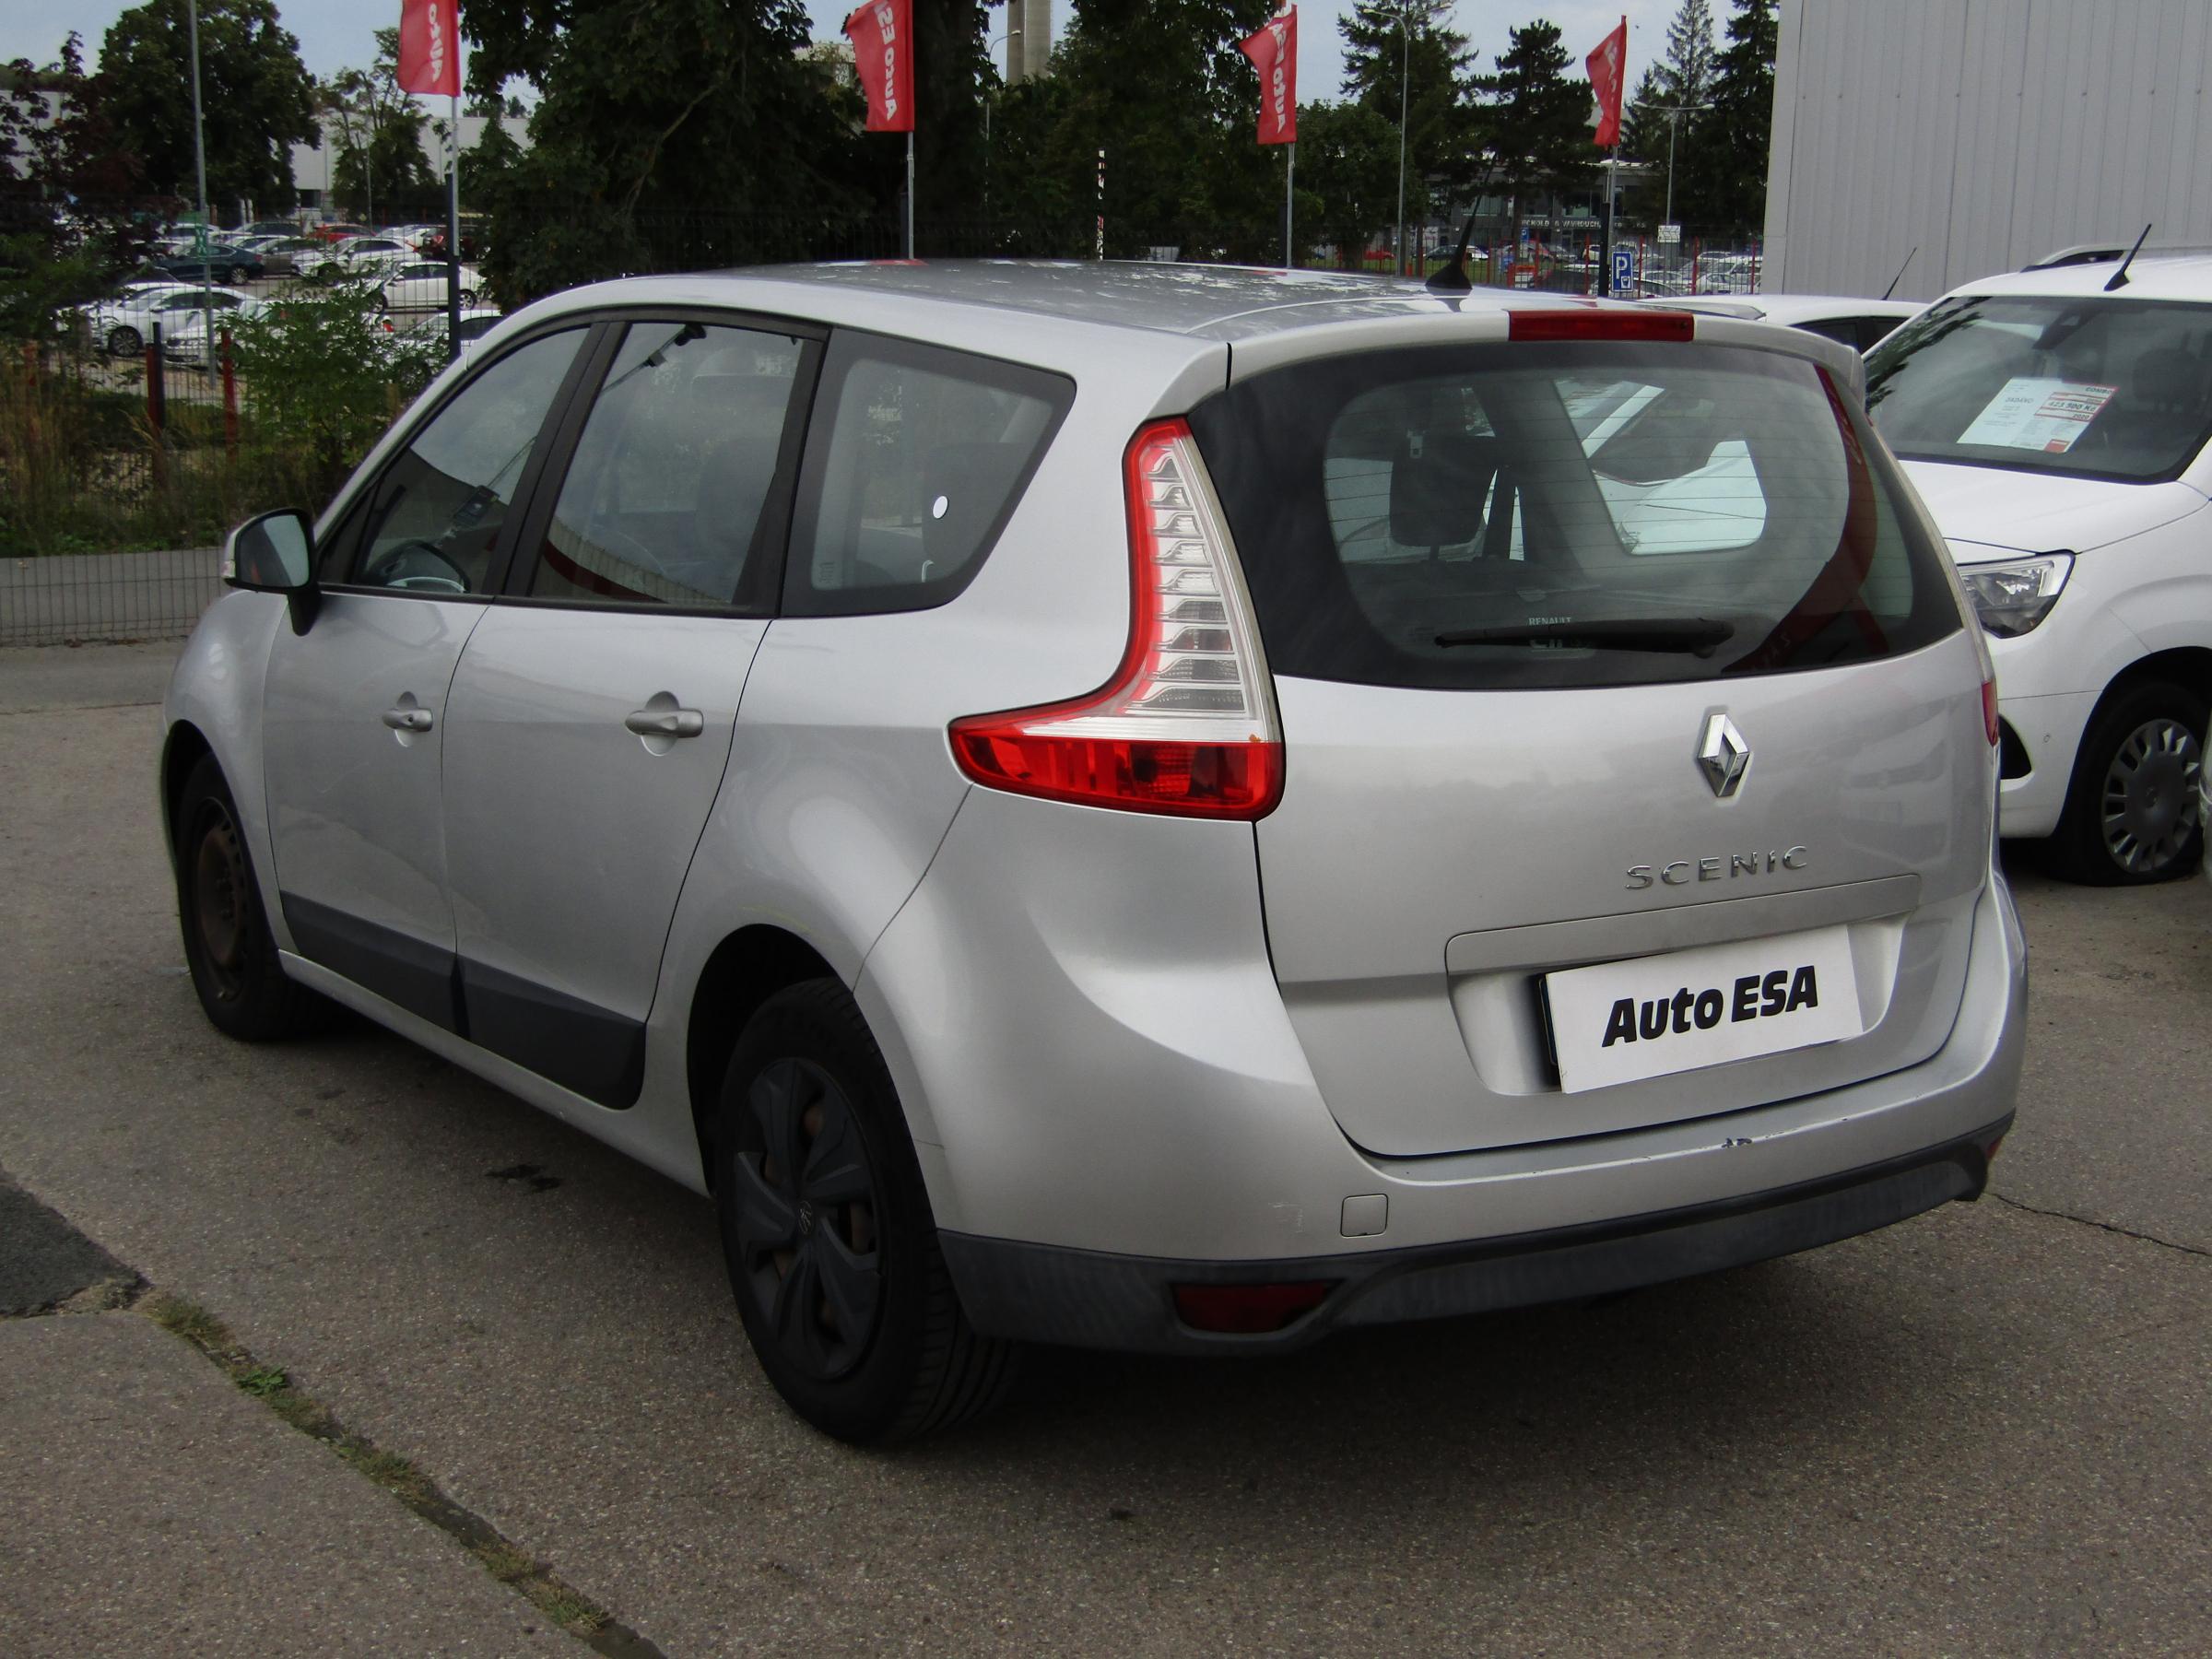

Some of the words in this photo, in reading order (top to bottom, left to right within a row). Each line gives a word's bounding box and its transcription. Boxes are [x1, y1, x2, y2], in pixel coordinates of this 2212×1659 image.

[1616, 256, 1628, 279] P
[1528, 617, 1571, 625] RENAULT
[1626, 845, 1807, 889] SCENIC
[1602, 987, 1724, 1047] Auto
[1731, 965, 1818, 1022] ESA
